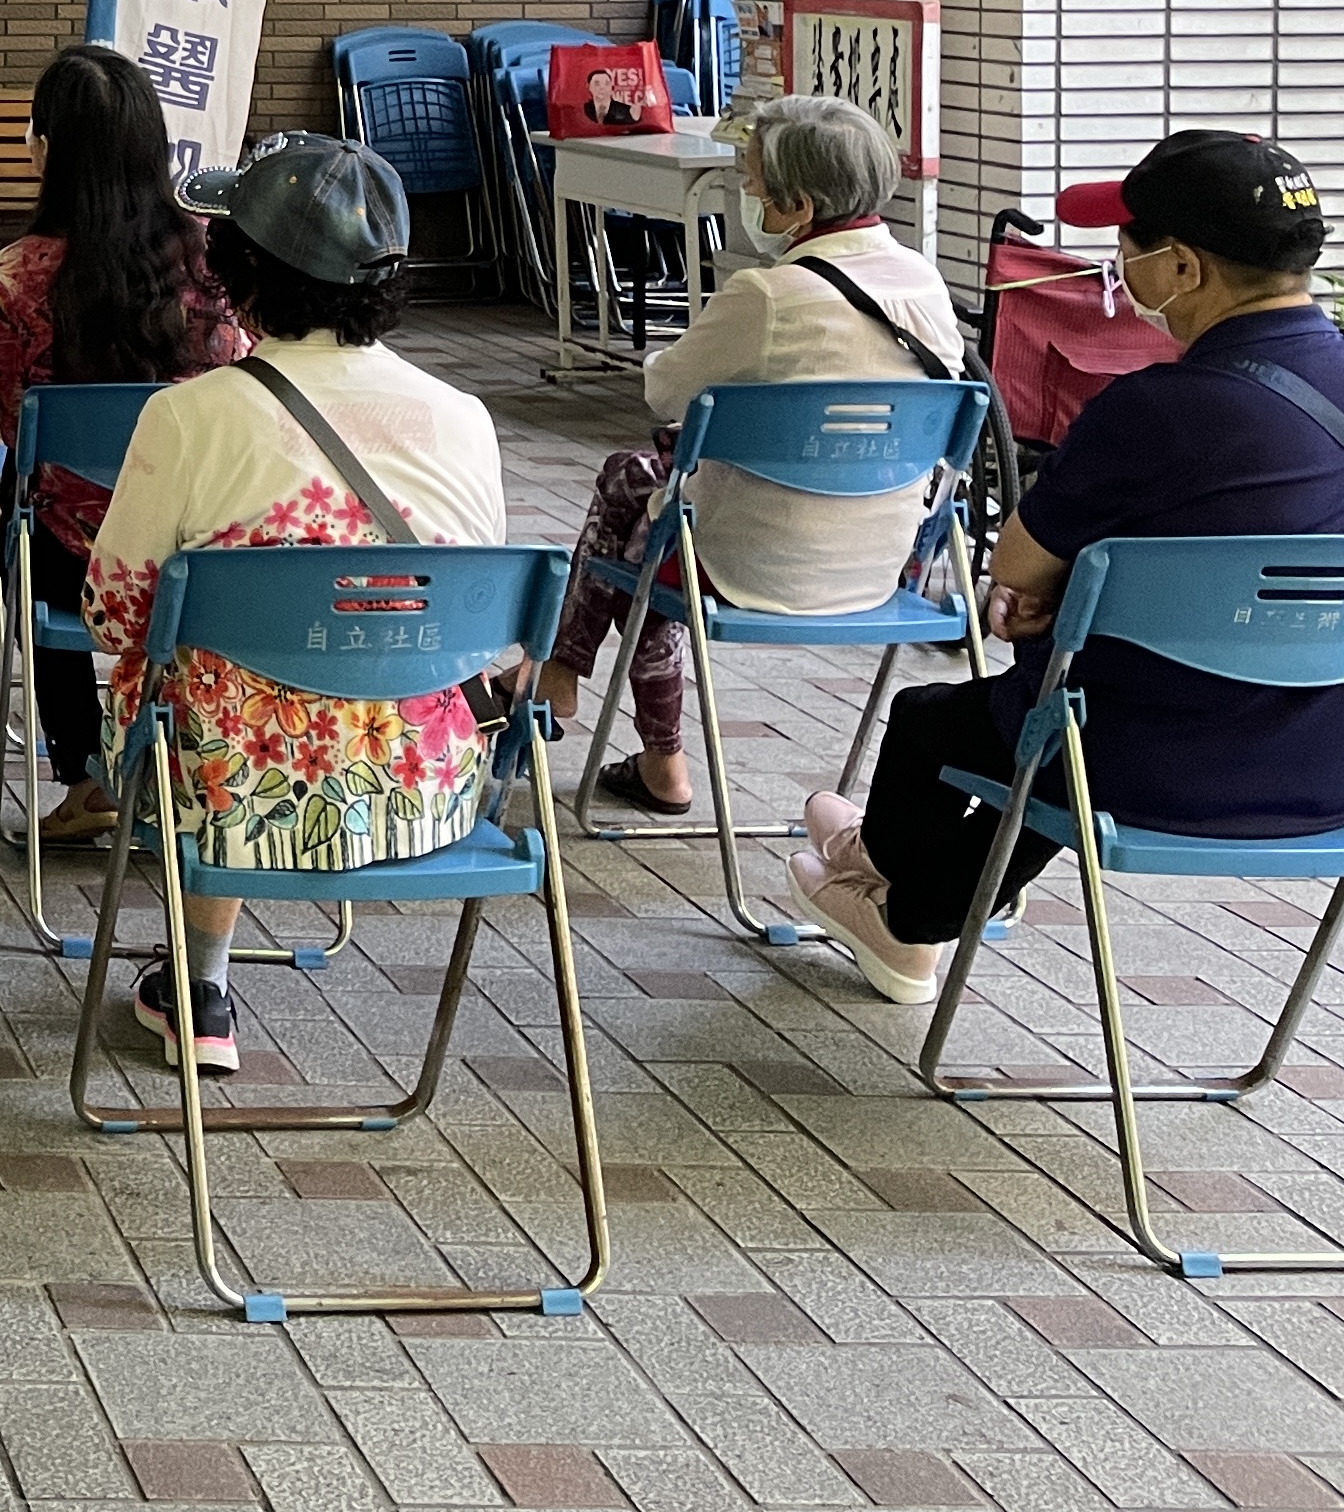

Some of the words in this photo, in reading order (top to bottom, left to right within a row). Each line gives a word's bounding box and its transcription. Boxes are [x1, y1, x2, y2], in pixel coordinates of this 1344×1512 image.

[605, 68, 643, 87] YES!
[306, 620, 442, 652] 自立社區
